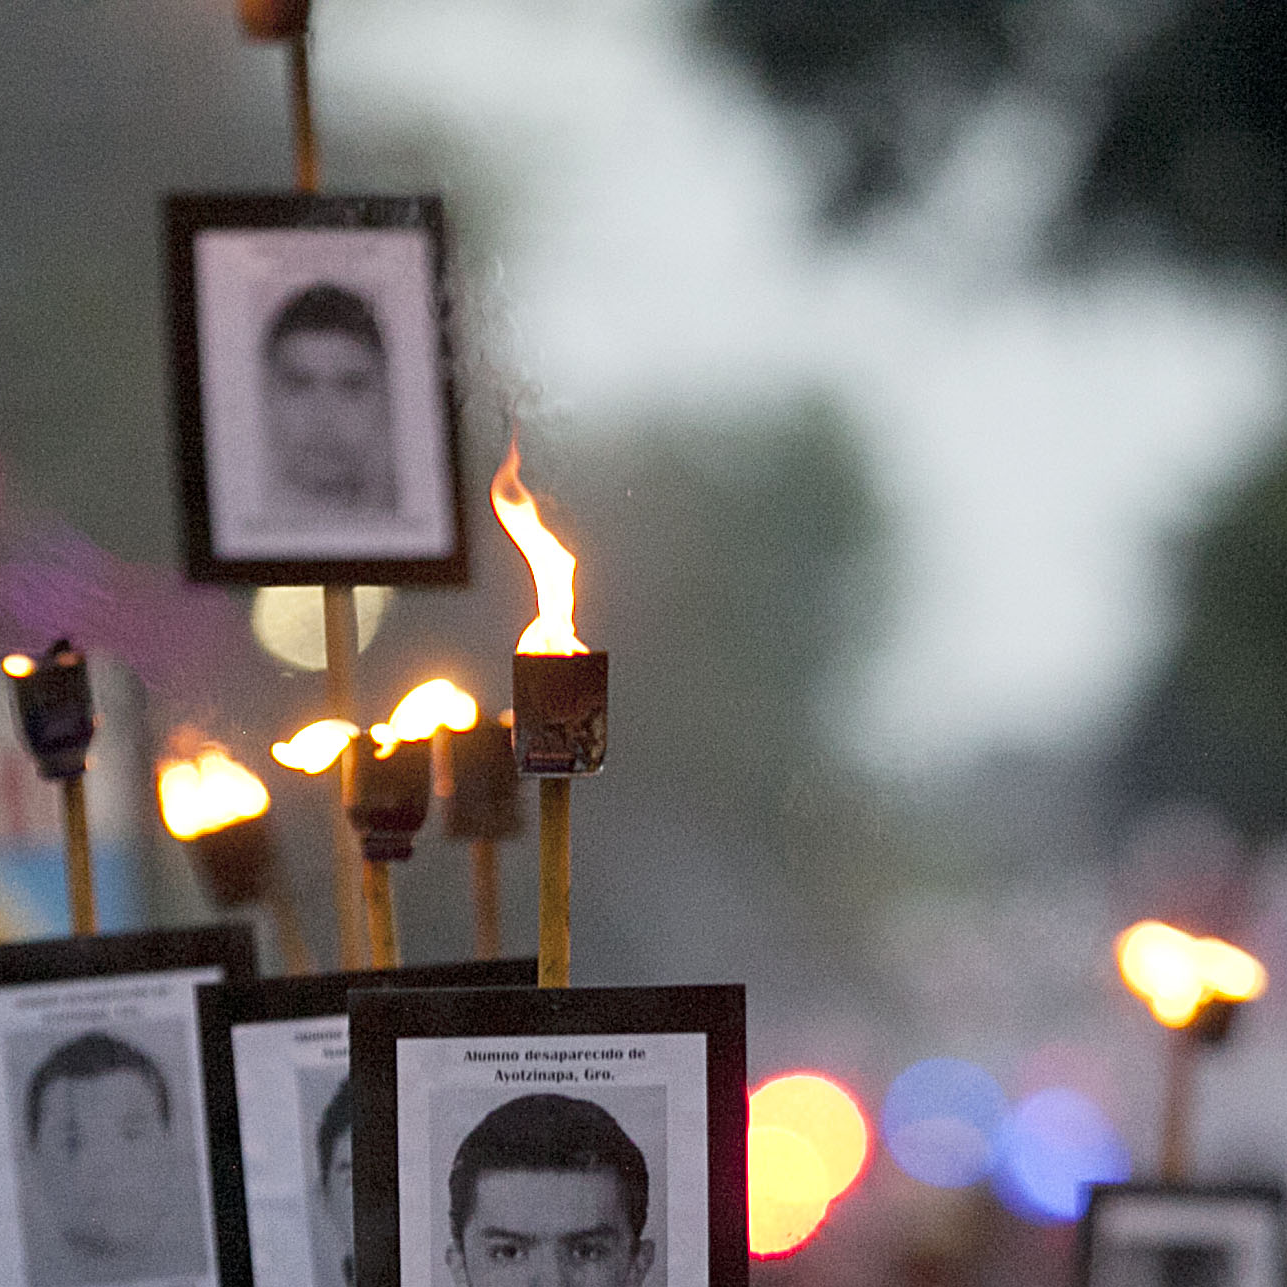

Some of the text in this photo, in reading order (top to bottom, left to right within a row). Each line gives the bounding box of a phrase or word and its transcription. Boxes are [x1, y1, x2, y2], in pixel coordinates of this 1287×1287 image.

[464, 1048, 646, 1063] Alumno desaparecido de
[494, 1068, 615, 1083] Ayotzinapa, Gro.
